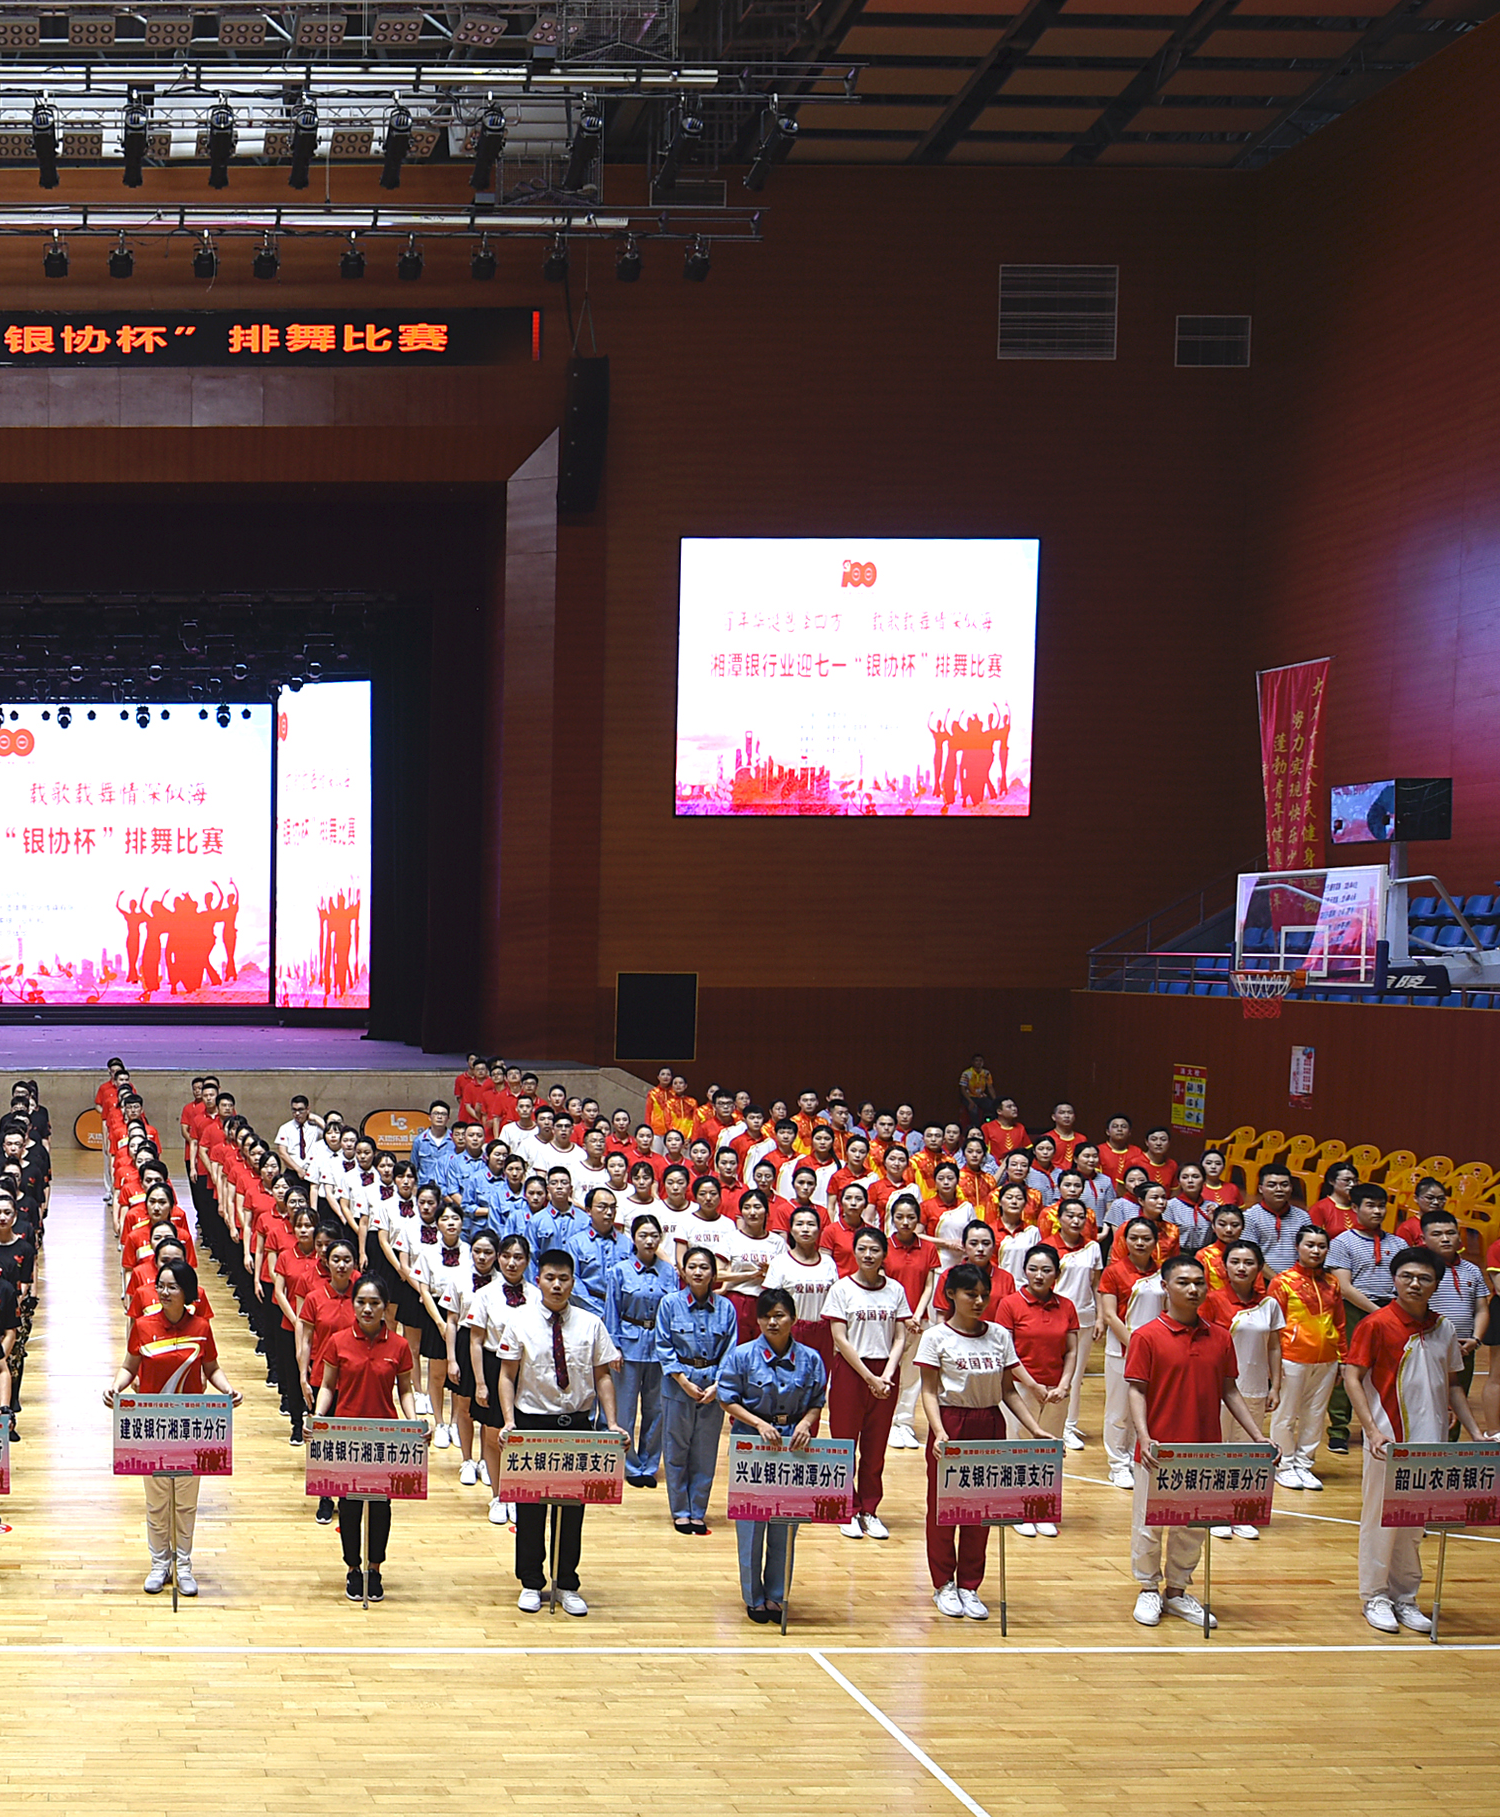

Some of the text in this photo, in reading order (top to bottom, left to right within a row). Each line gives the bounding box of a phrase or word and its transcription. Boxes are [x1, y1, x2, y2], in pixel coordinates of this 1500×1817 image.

[1271, 732, 1288, 912] 蓬勃青年健康年
[120, 1417, 227, 1441] 建设银行湘潭市分行
[310, 1439, 424, 1465] 邮储银行湘潭市分行
[506, 1452, 617, 1474] 光大银行湘潭支行
[736, 1461, 847, 1489] 兴业银行湘潭分行
[945, 1464, 1055, 1489] 广发银行湘潭支行
[1156, 1468, 1268, 1491] 长沙银行湘潭分行
[1395, 1467, 1495, 1491] 韶山农商银行
